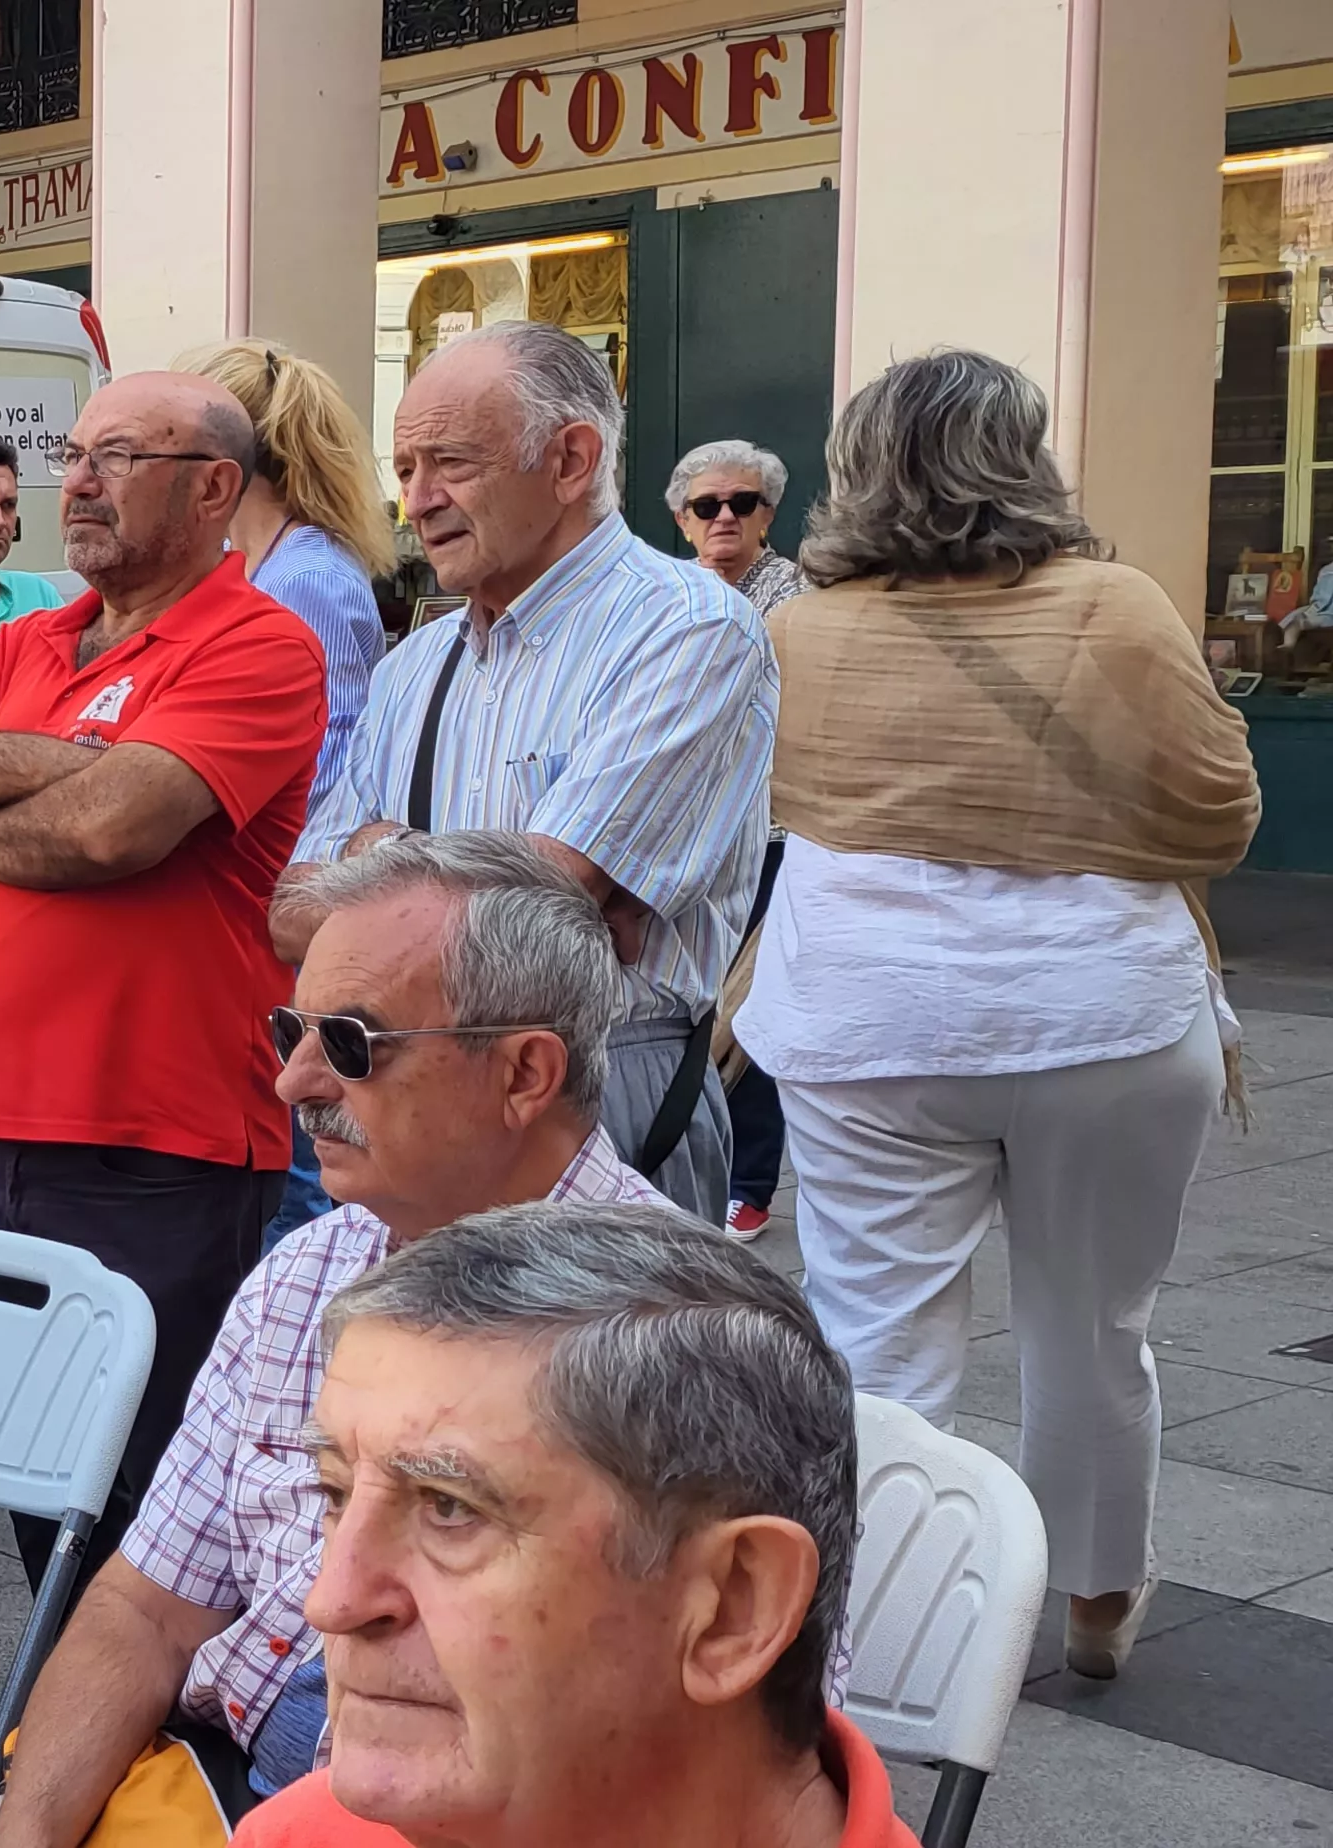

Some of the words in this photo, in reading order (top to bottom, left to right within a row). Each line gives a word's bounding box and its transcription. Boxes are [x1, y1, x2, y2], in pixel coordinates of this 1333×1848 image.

[386, 101, 445, 188] A
[6, 407, 26, 426] yo
[30, 403, 44, 423] al
[18, 430, 32, 449] el
